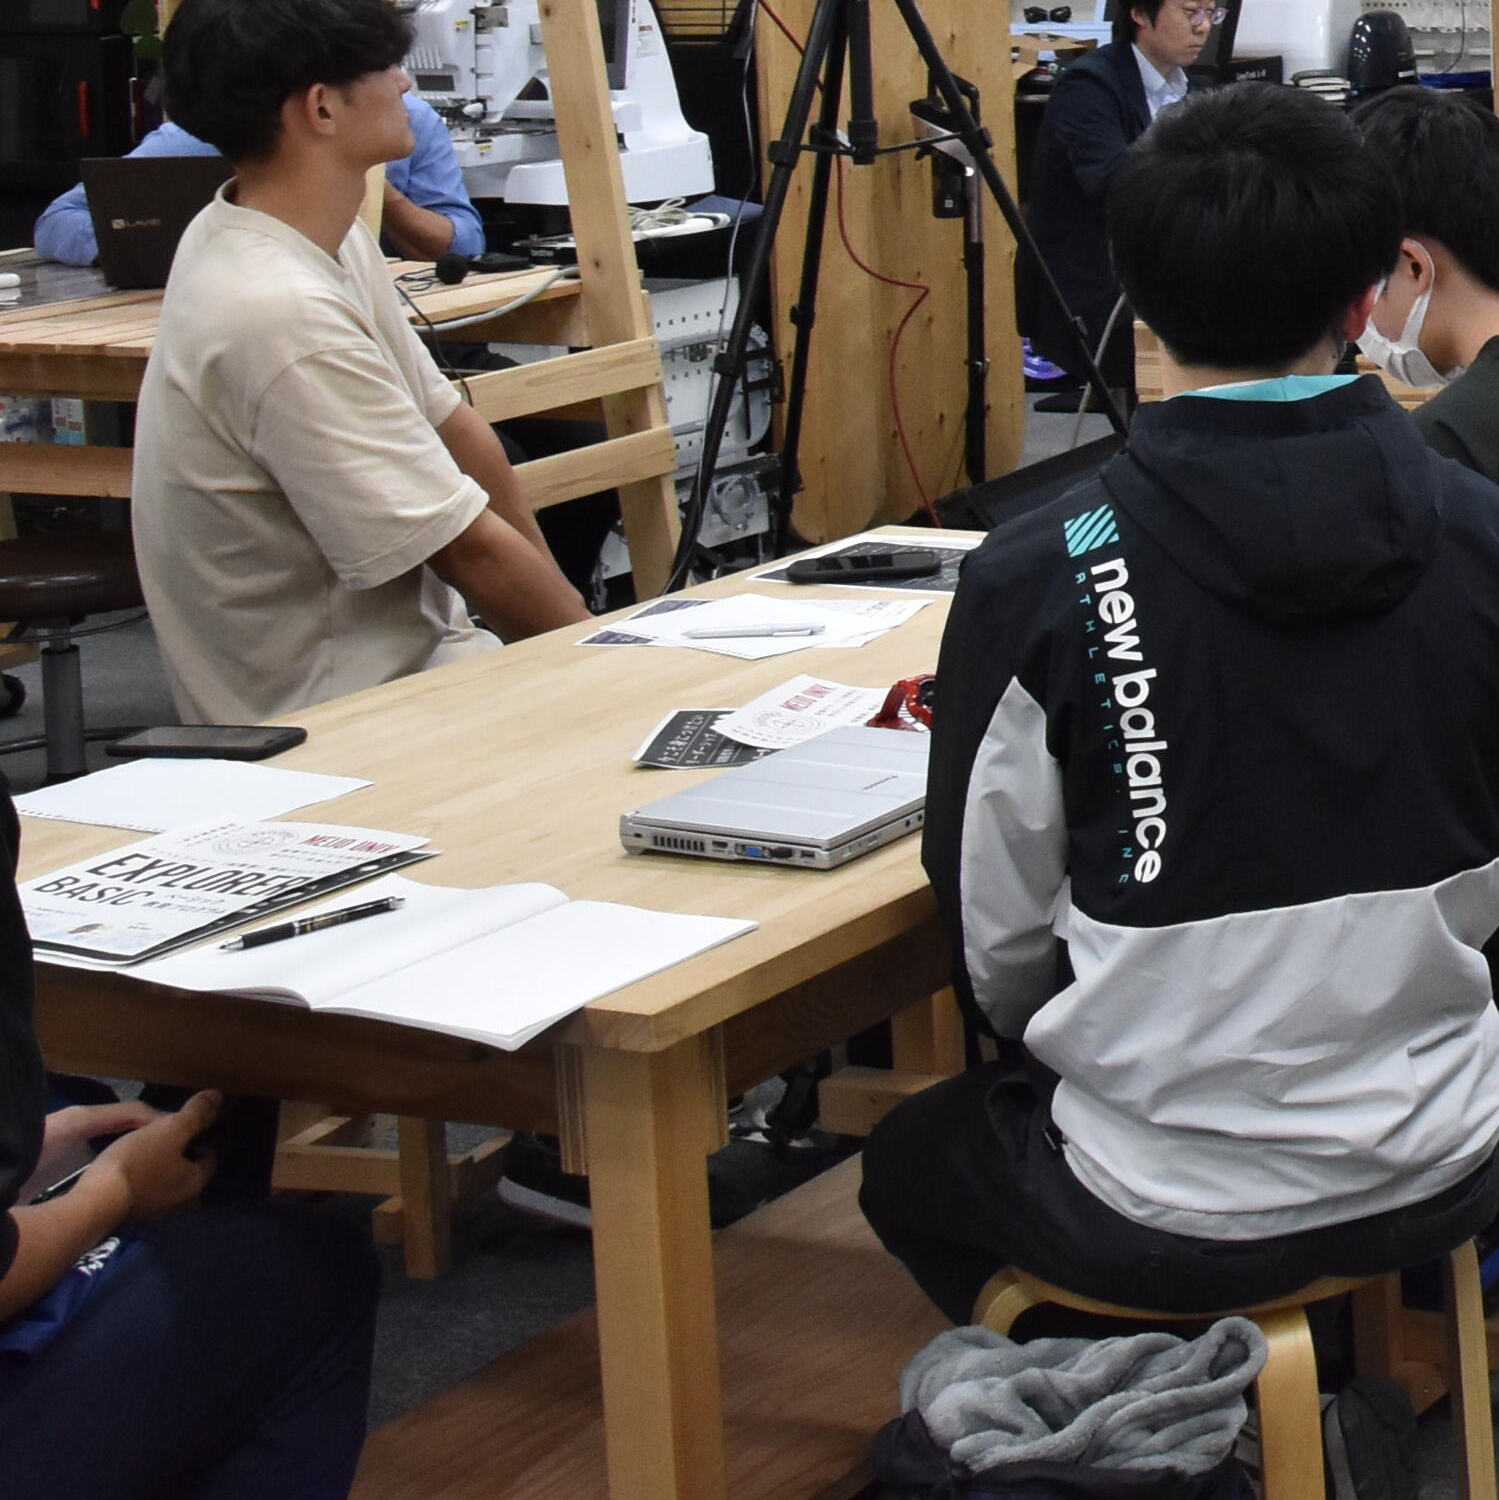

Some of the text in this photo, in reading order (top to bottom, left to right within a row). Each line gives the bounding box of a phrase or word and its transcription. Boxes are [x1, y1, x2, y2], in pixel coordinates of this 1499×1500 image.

[1091, 557, 1168, 883] new balance
[34, 875, 154, 907] BASIC
